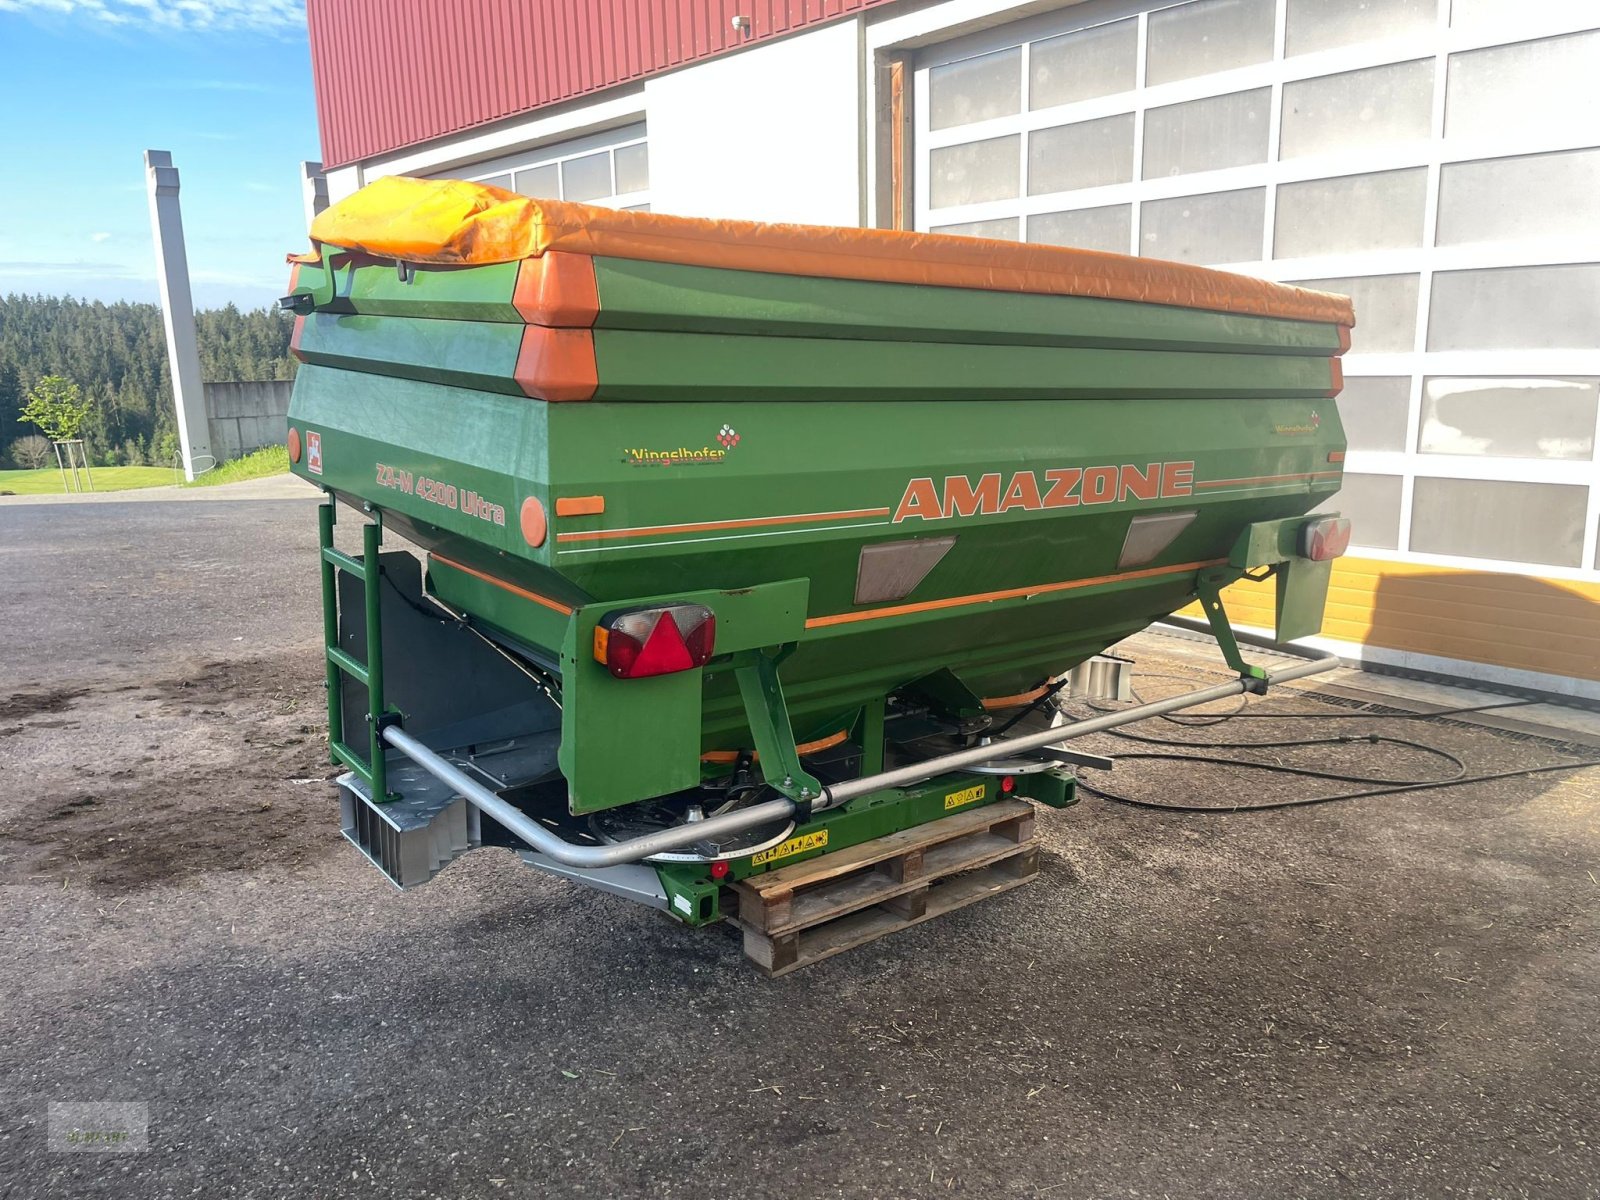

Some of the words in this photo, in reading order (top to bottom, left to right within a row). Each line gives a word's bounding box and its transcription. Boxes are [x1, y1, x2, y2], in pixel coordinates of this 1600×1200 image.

[376, 462, 413, 495] ZA-M
[416, 476, 457, 509] 4200
[461, 489, 505, 526] Ultra
[892, 460, 1195, 523] AMAZONE
